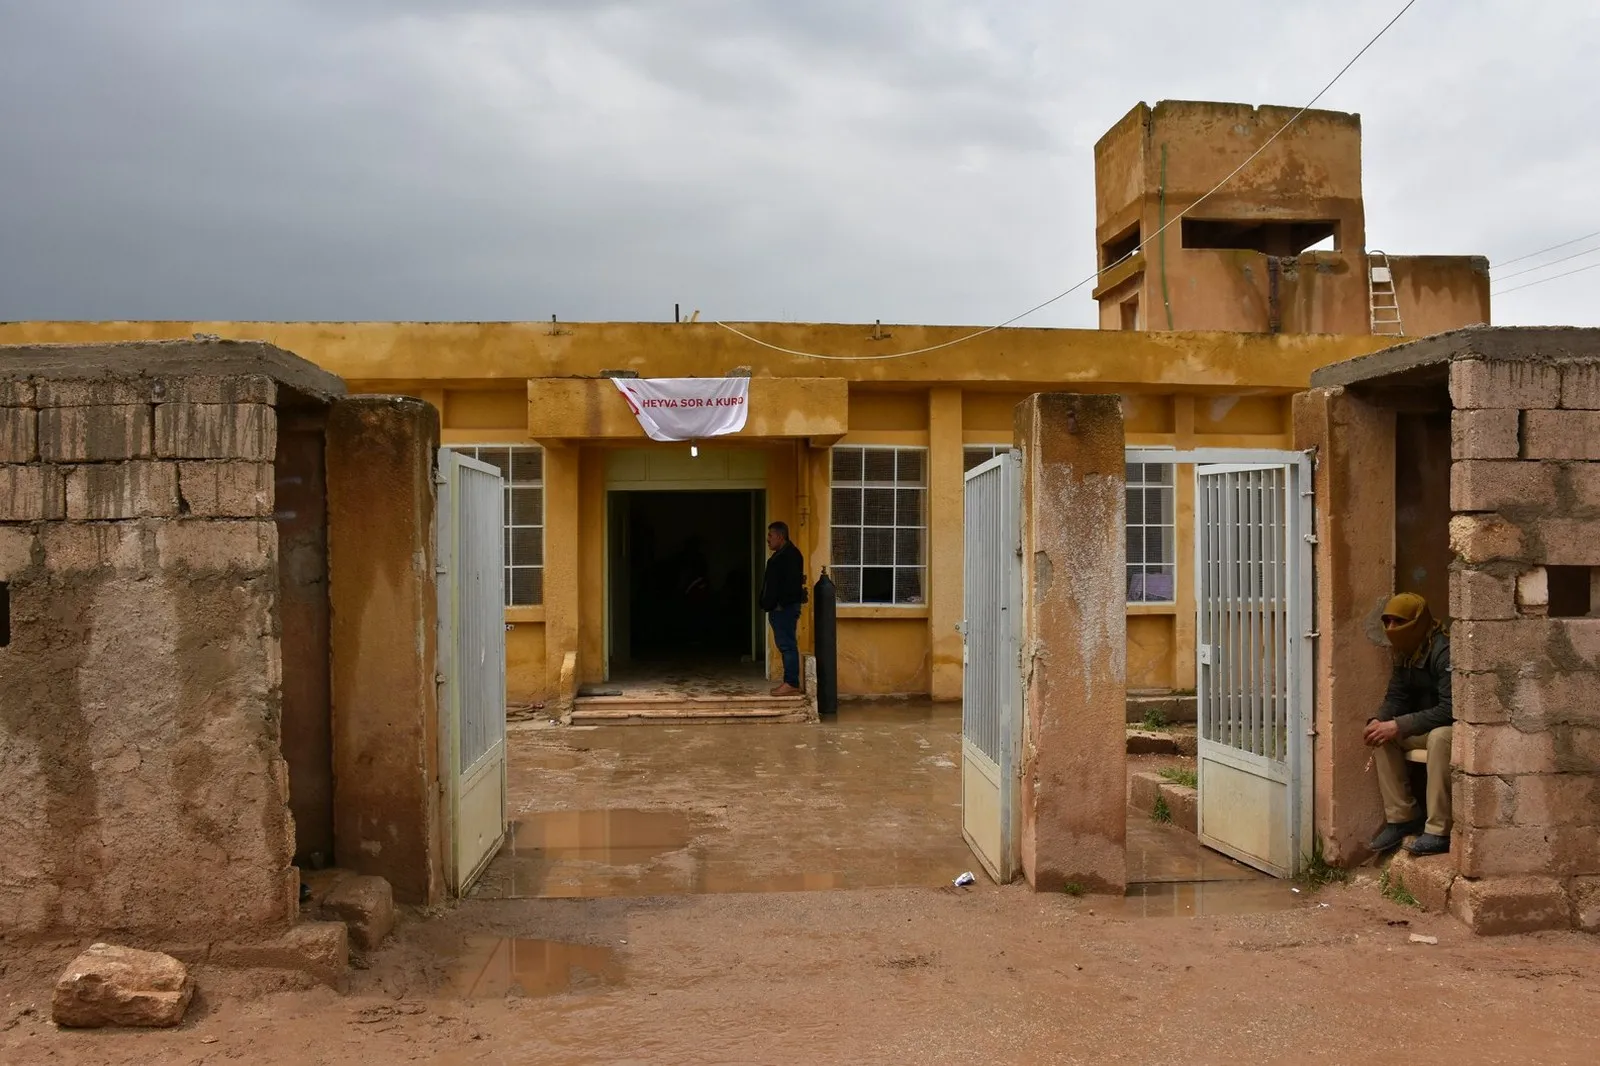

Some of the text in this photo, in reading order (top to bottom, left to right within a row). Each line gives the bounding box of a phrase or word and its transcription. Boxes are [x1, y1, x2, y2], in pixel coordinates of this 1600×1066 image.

[642, 399, 678, 408] HEYVA
[680, 399, 703, 407] SOR
[705, 399, 713, 407] A
